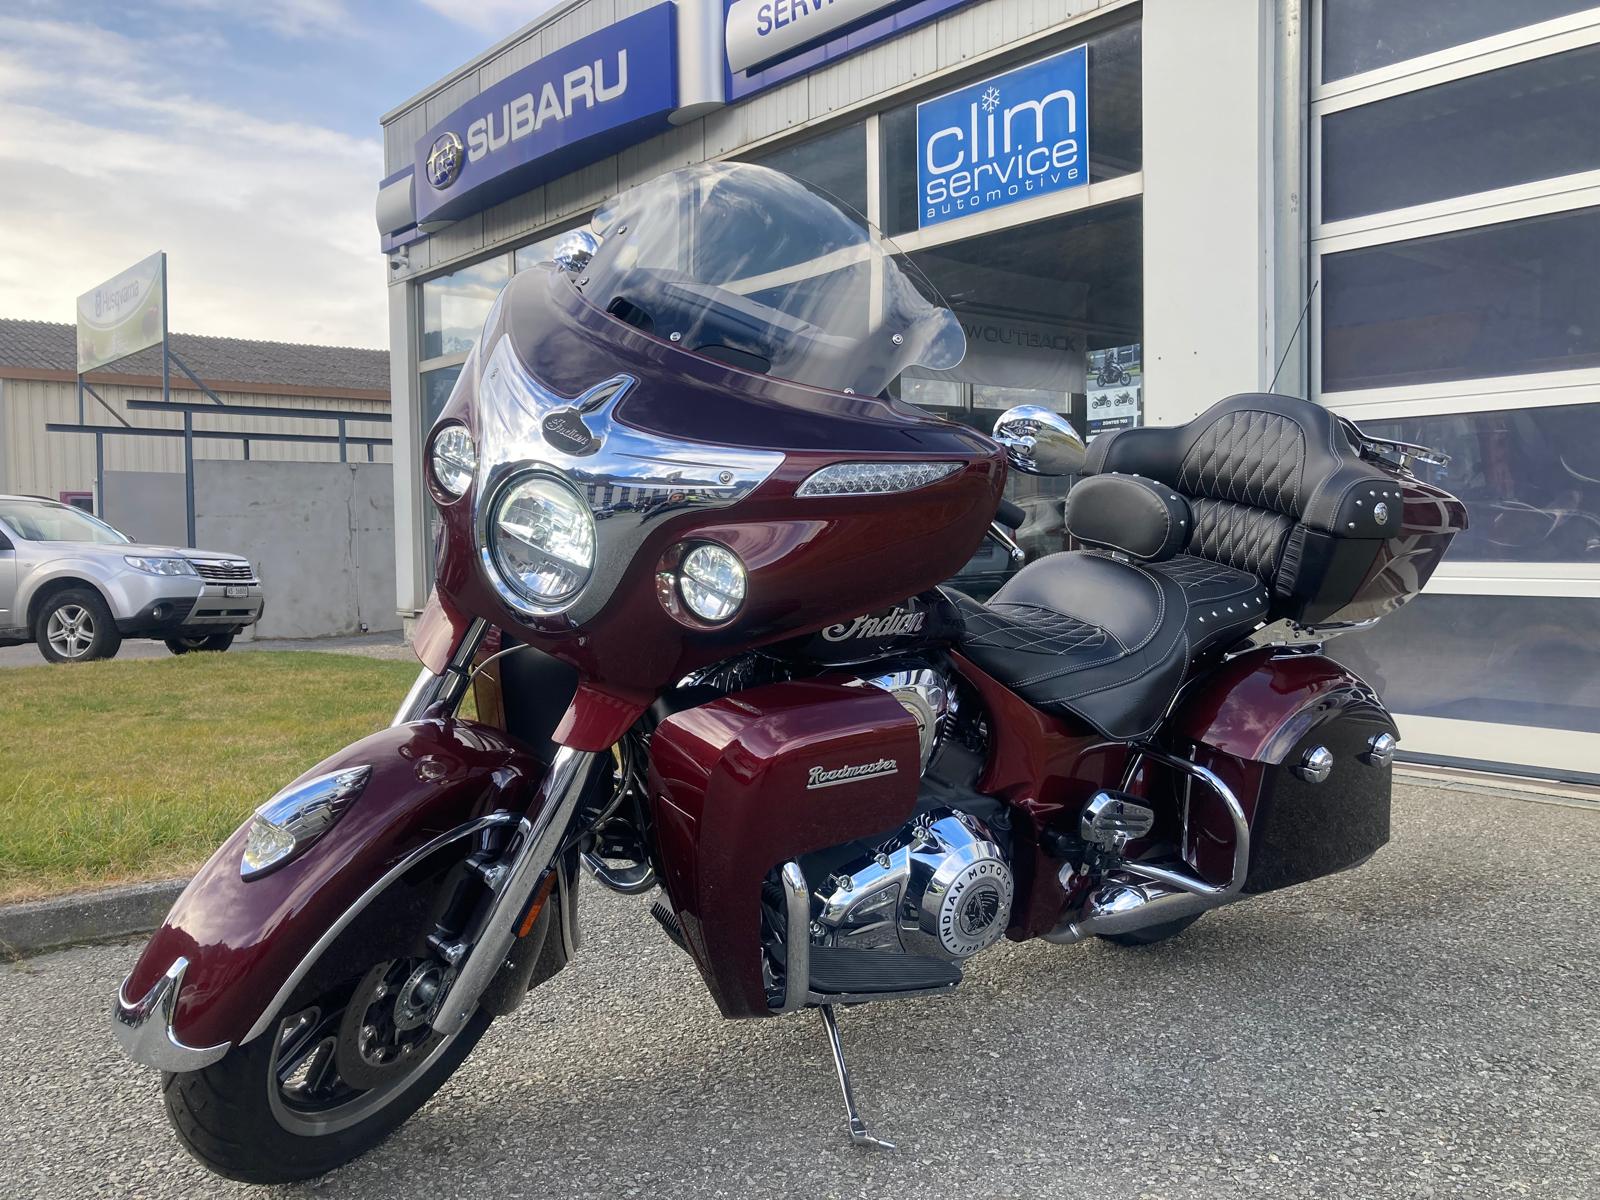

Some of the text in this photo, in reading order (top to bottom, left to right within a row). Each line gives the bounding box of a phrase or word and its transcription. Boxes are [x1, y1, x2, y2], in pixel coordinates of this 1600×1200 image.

[757, 0, 835, 36] SER
[467, 48, 628, 164] SUBARU
[926, 89, 1076, 175] clim
[926, 139, 1078, 204] service
[926, 168, 1078, 218] automotive
[545, 418, 590, 445] Indian
[822, 604, 926, 642] Indian
[807, 757, 898, 788] Roadmaster
[942, 882, 965, 944] INDIAN
